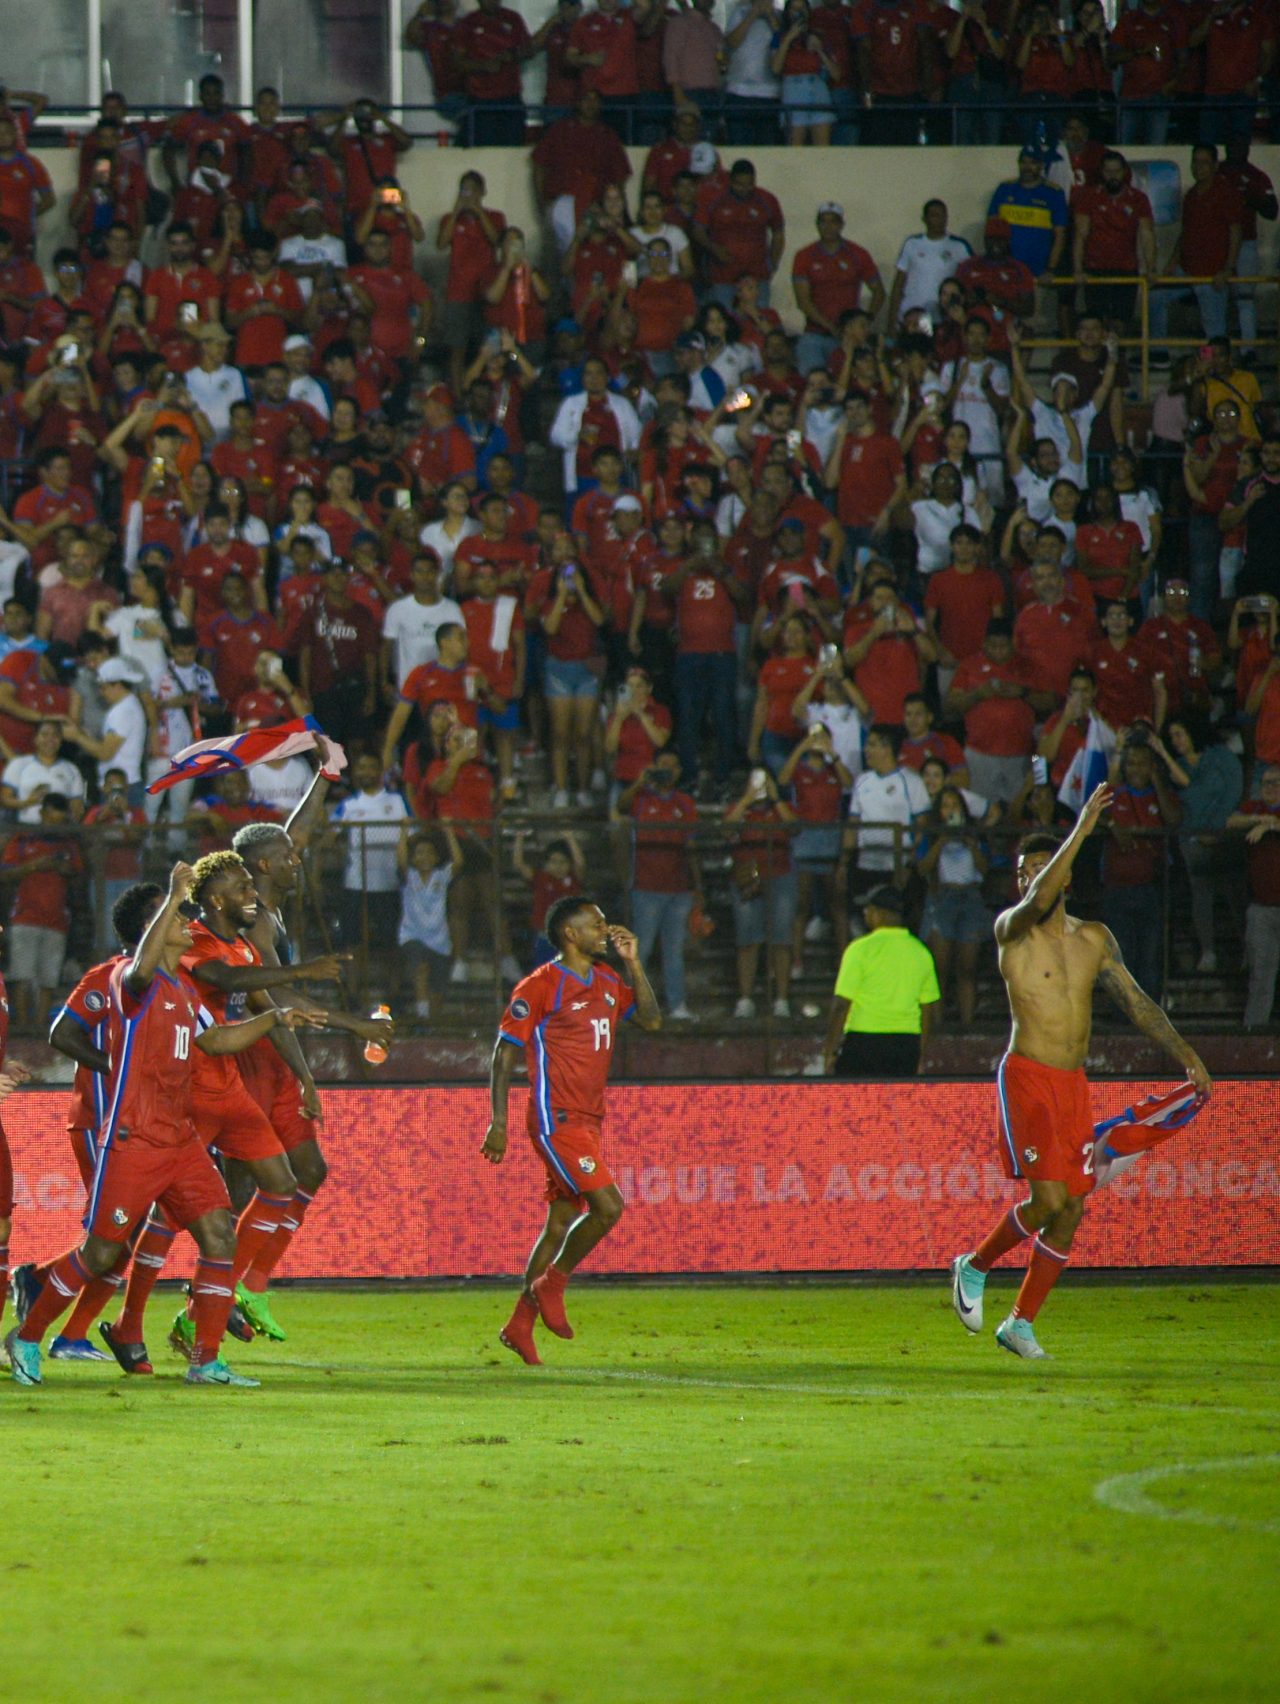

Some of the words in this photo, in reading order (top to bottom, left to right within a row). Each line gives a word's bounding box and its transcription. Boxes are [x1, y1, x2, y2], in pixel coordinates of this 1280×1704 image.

[694, 579, 715, 600] 25
[175, 1025, 190, 1060] 10
[590, 1018, 610, 1052] 19
[609, 1164, 736, 1203] IGUE
[750, 1163, 810, 1203] LA
